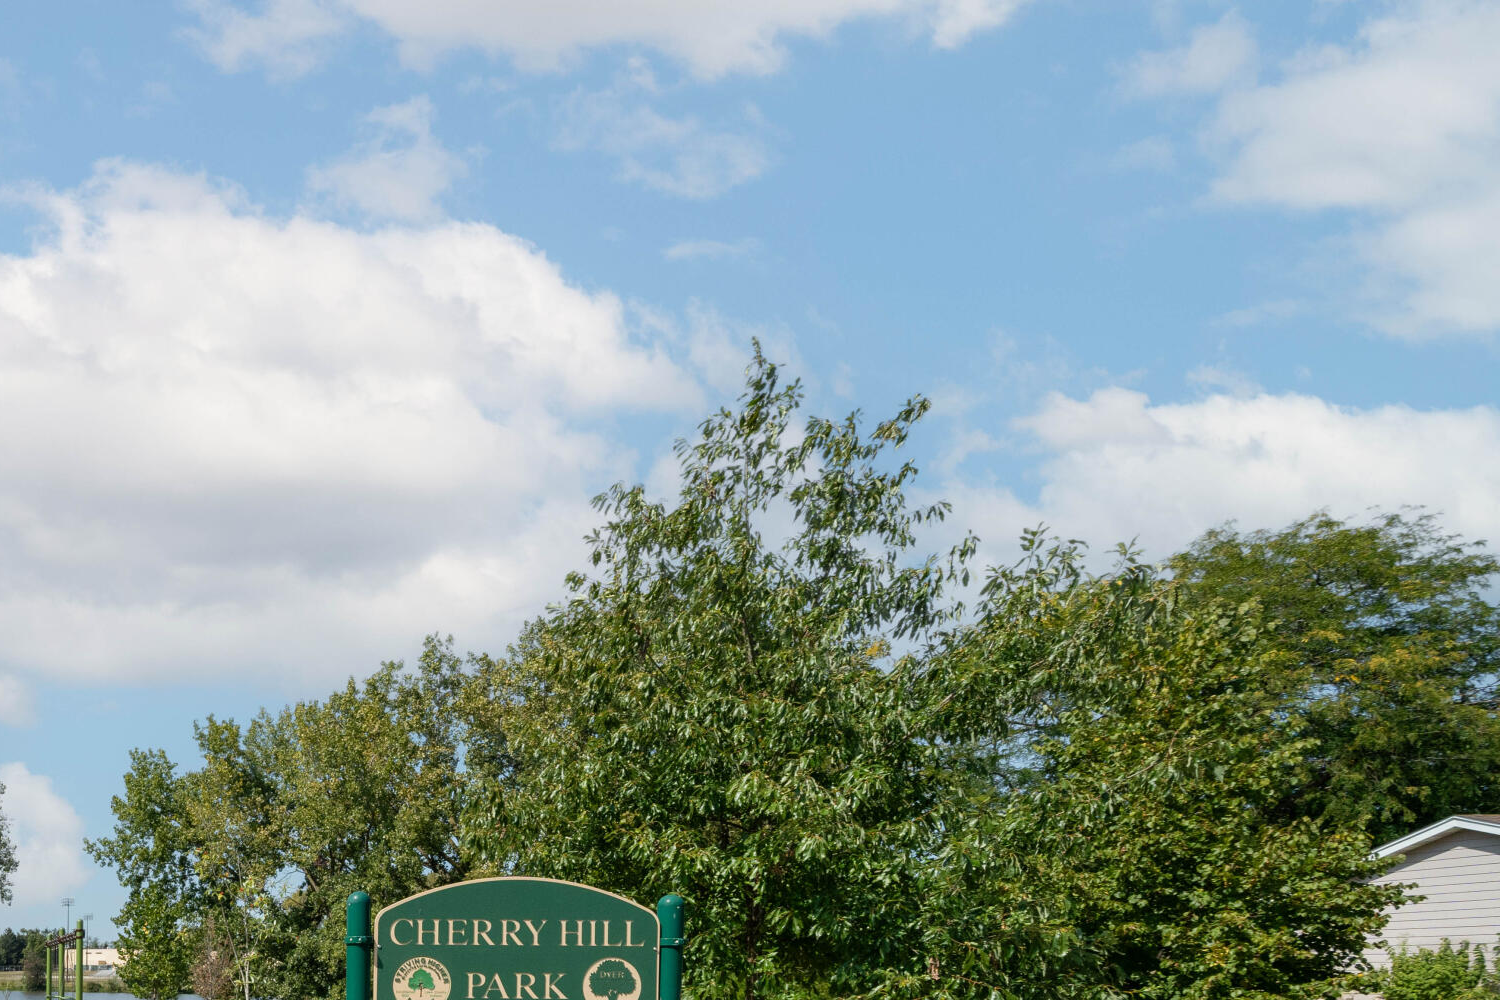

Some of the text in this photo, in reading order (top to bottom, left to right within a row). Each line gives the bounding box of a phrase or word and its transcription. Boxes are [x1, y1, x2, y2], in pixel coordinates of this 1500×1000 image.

[390, 918, 645, 947] CHERRY HILL
[466, 972, 568, 1000] PARK
[600, 970, 625, 979] DYER
